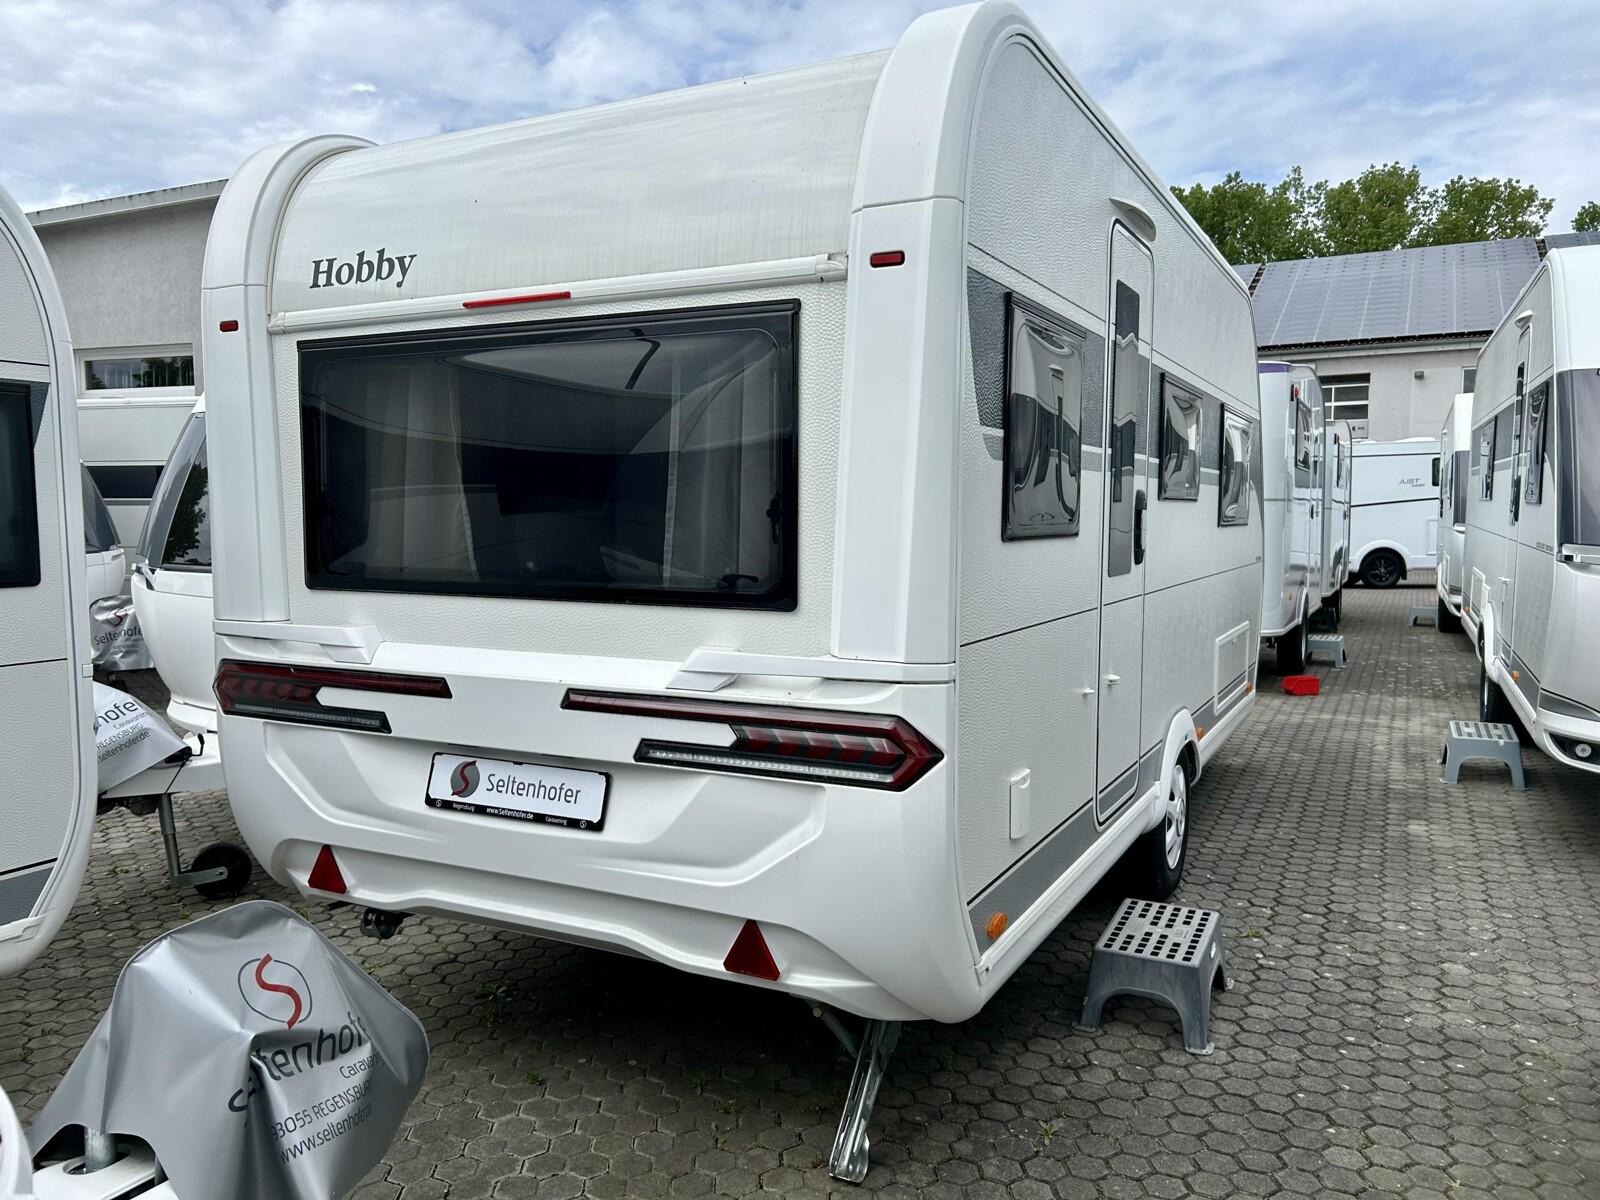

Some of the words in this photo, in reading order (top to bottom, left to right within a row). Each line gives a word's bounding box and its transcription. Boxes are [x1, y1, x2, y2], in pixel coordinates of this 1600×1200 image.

[309, 247, 418, 289] Hobby
[486, 773, 582, 805] Seltenhofer
[271, 1110, 313, 1142] 93055
